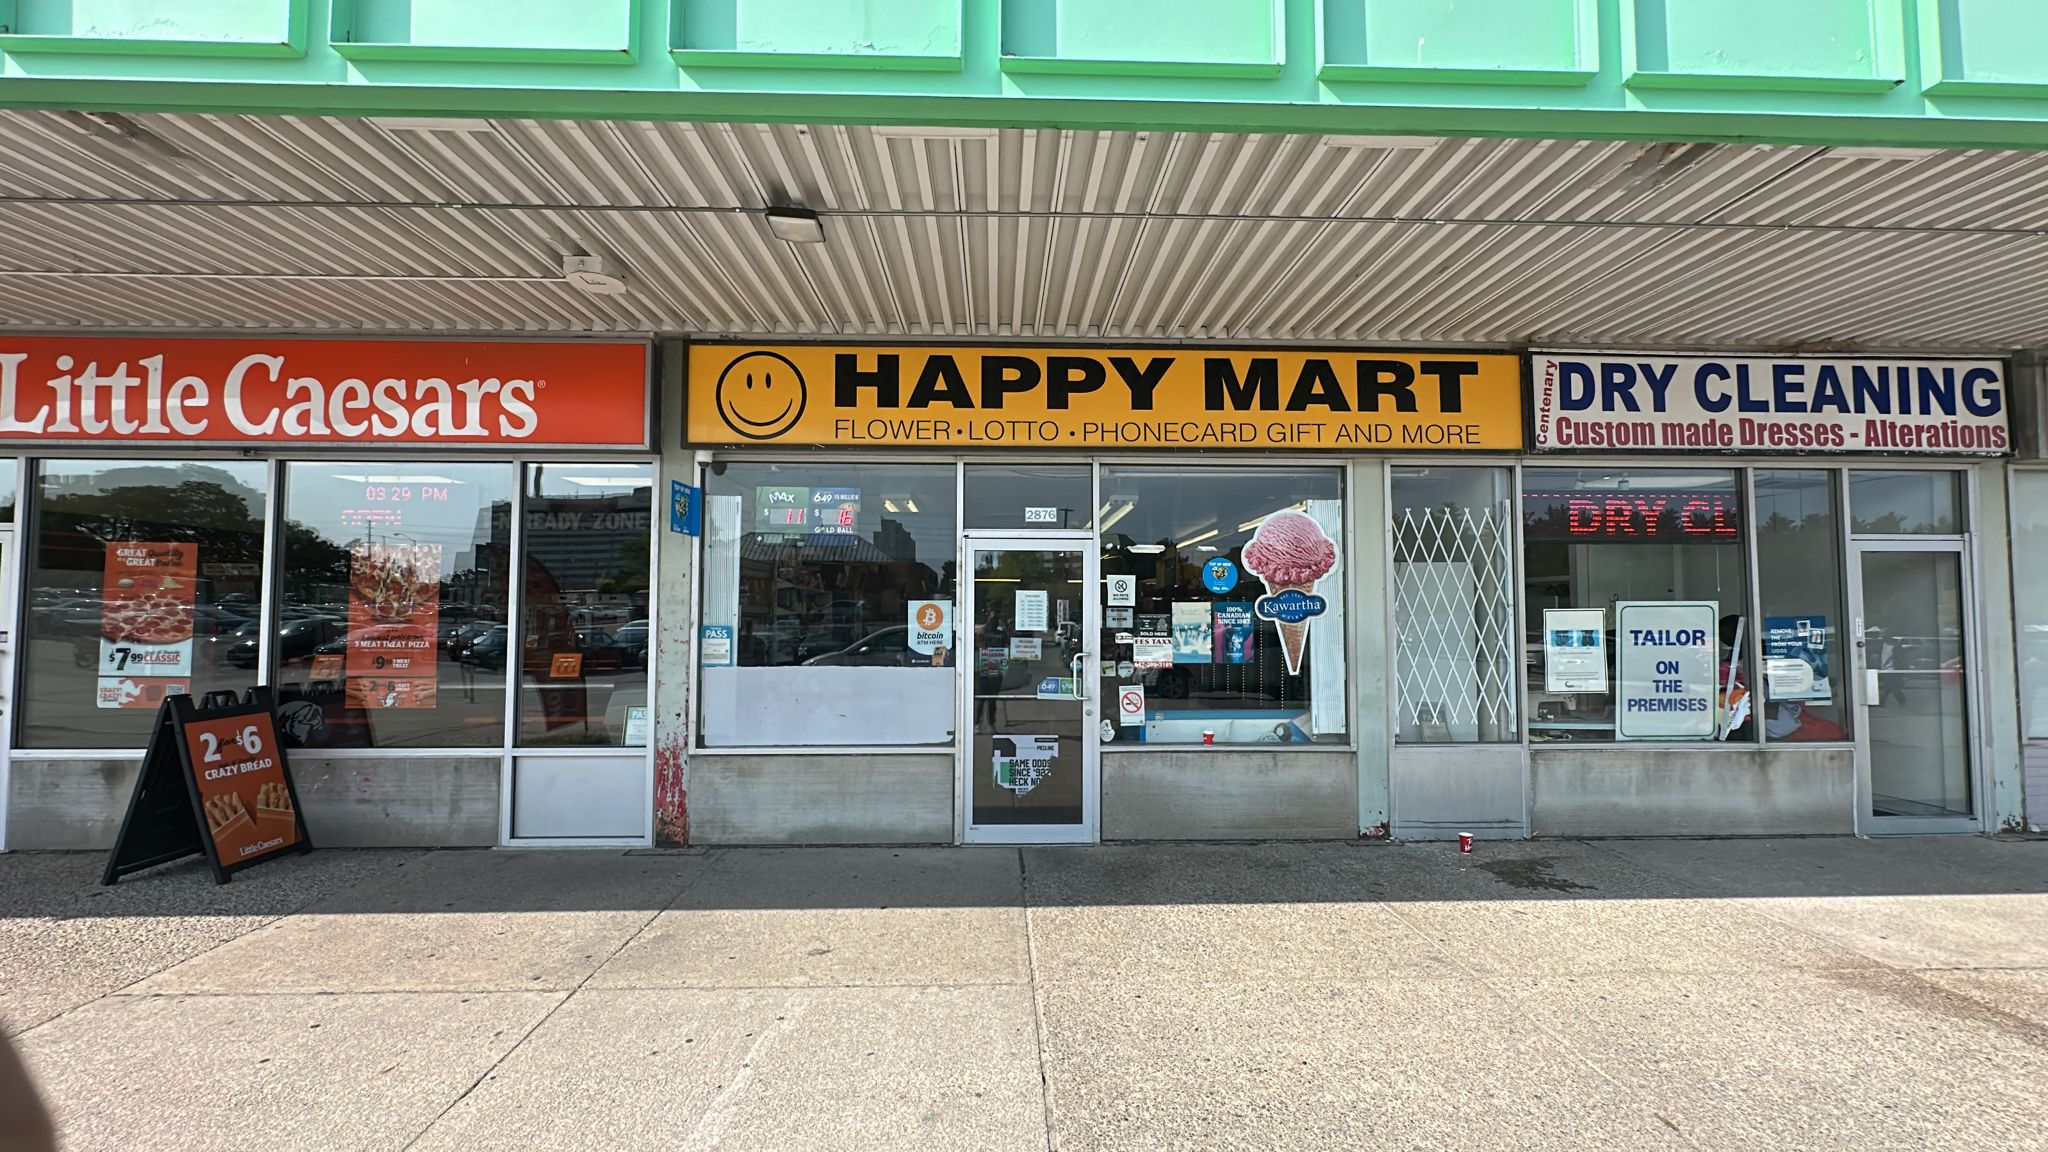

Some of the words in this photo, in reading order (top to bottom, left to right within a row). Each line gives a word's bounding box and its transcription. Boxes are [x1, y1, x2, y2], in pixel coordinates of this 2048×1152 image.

[834, 354, 1176, 410] HAPPY
[1204, 358, 1479, 413] MART
[1558, 361, 1679, 413] DRY
[1694, 362, 2002, 418] CLEANING
[0, 353, 209, 435] Little
[224, 354, 538, 438] Caesars
[1536, 359, 1558, 445] Centenary
[834, 419, 950, 440] FLOWER
[969, 420, 1059, 441] LOTTO
[1083, 422, 1257, 442] PHONECARD
[1267, 423, 1327, 443] GIFT
[1335, 424, 1393, 444] AND
[1402, 424, 1481, 444] MORE
[1556, 416, 1656, 448] Custom
[1661, 418, 1734, 447] made
[1739, 418, 1845, 447] Dresses
[1865, 419, 2007, 449] Alterations
[422, 487, 448, 501] PM
[769, 491, 794, 503] MAX
[813, 491, 832, 502] 649
[593, 511, 648, 530] ZONE
[1026, 509, 1056, 520] 2876
[1568, 500, 1666, 535] DRY
[117, 548, 148, 558] GREAT
[127, 557, 156, 567] GREAT
[1263, 599, 1321, 614] Kawartha
[705, 629, 727, 638] PASS
[917, 631, 944, 640] bitcoin
[1630, 629, 1706, 646] TAILOR
[144, 654, 181, 663] CLASSIC
[1655, 660, 1680, 675] ON
[1653, 679, 1683, 693] THE
[1627, 698, 1708, 712] PREMISES
[200, 732, 221, 763] 2
[204, 764, 238, 780] CRAZY
[240, 758, 272, 774] BREAD
[1009, 759, 1030, 768] SAME
[1009, 769, 1031, 777] SINCE
[1009, 778, 1029, 786] HECK
